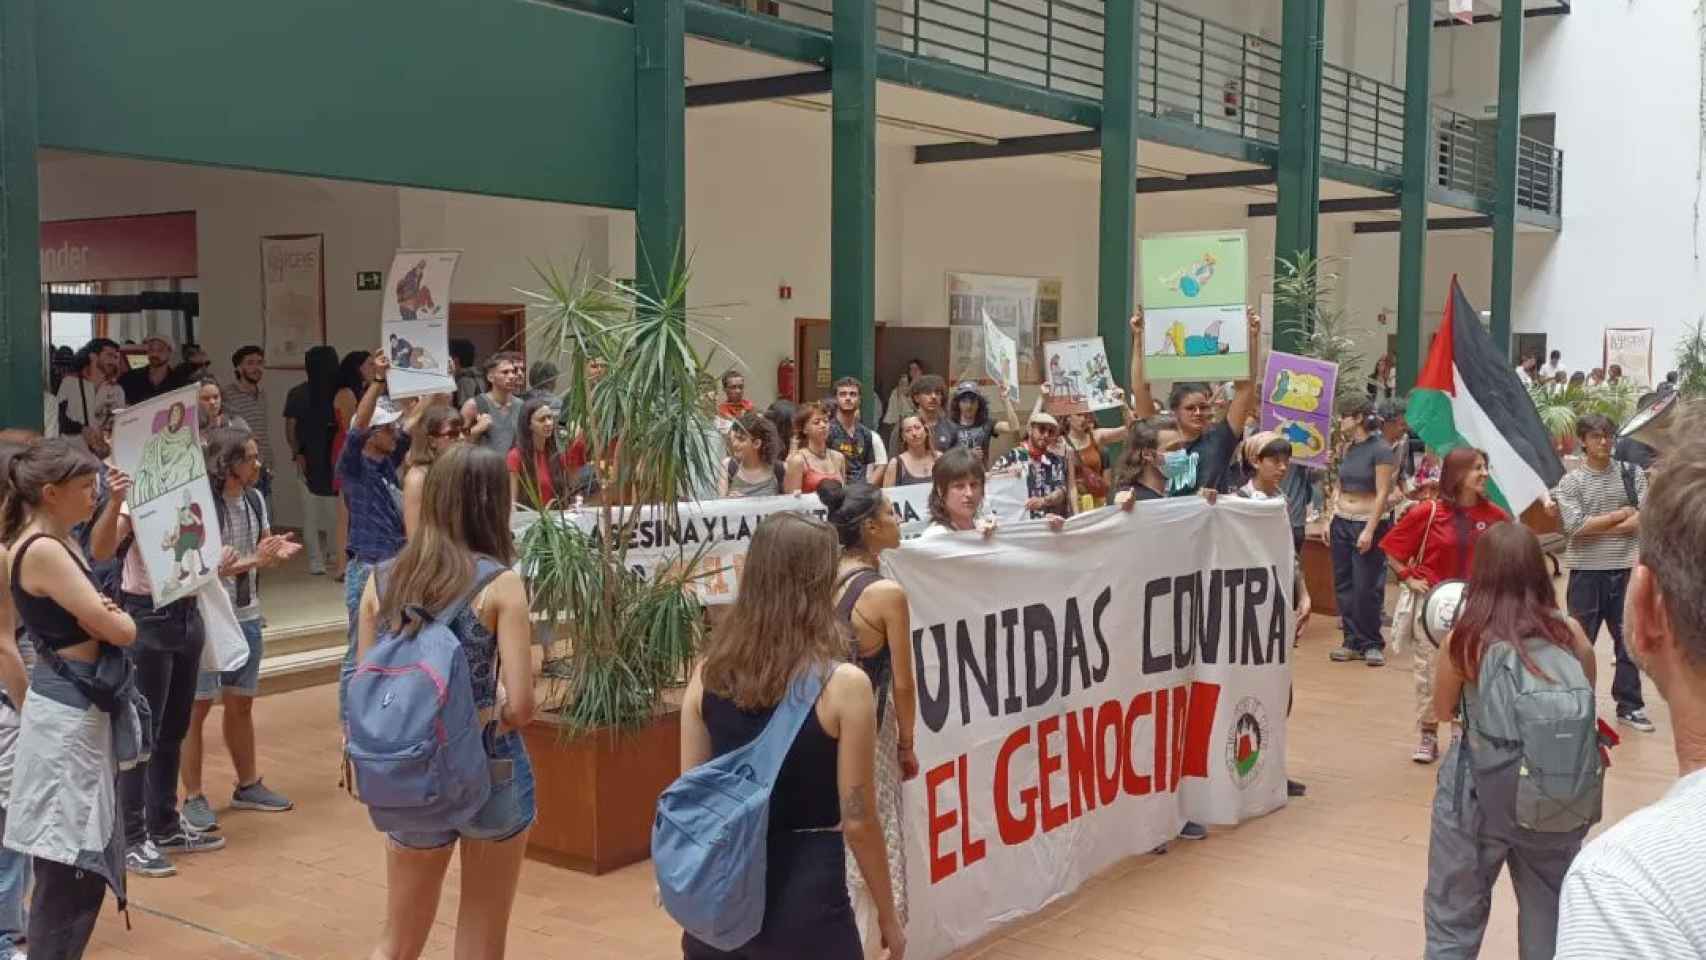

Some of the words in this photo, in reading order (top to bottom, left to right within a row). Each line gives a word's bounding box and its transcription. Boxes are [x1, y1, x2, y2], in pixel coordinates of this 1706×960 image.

[40, 240, 88, 273] nder
[702, 516, 717, 542] Y
[721, 514, 751, 541] LA
[912, 586, 1111, 733] UNIDAS
[1142, 566, 1287, 674] CONTRA
[925, 754, 986, 884] EL
